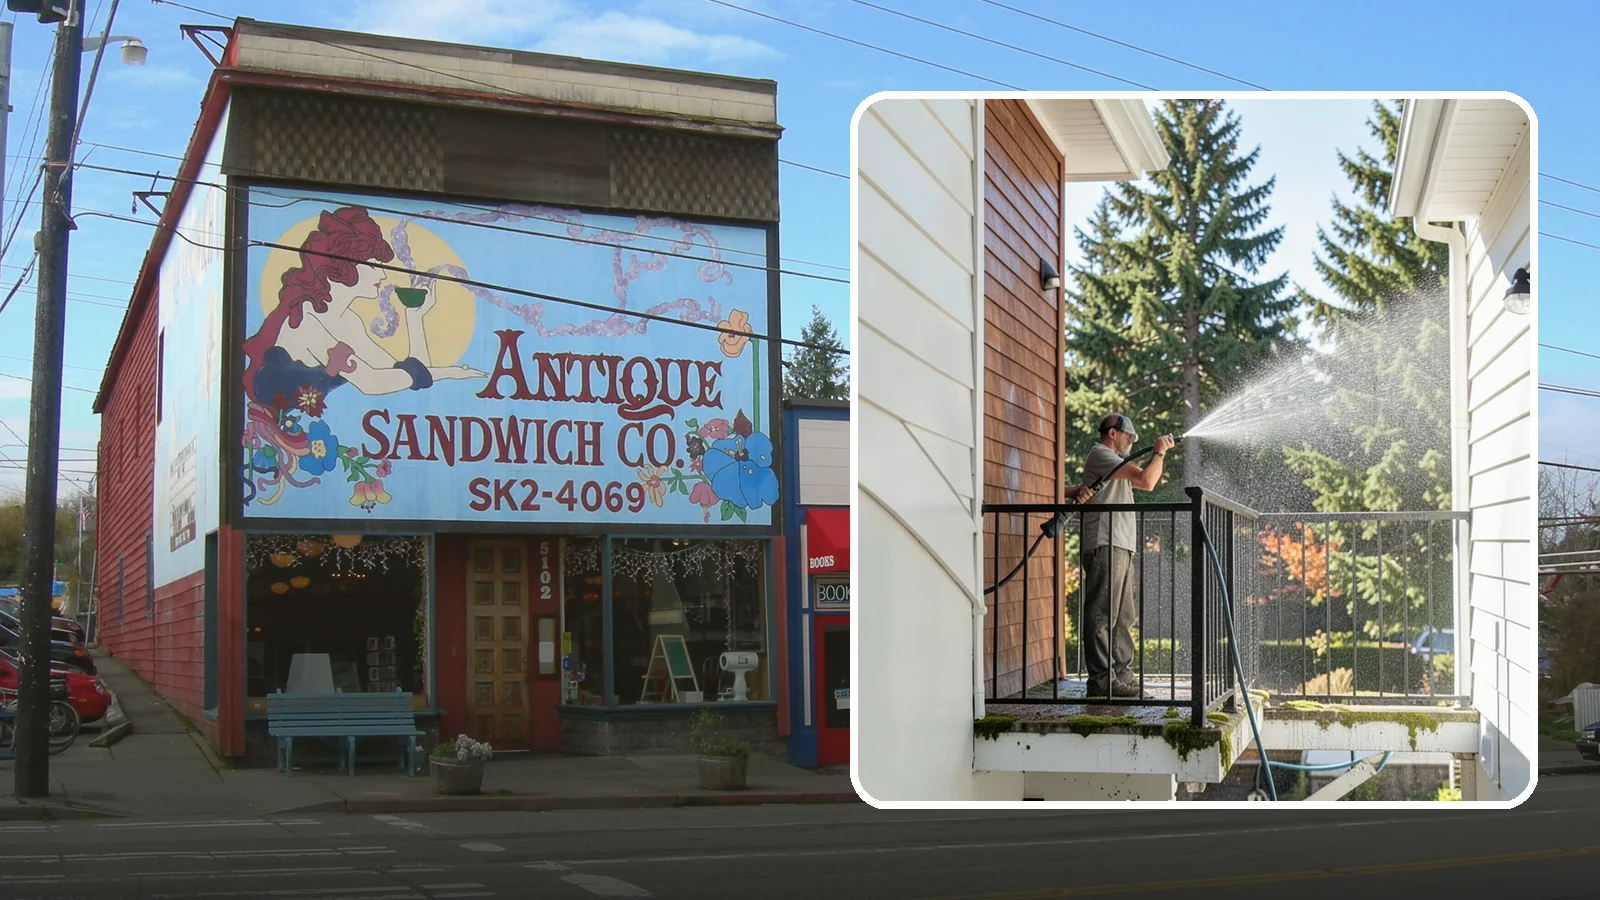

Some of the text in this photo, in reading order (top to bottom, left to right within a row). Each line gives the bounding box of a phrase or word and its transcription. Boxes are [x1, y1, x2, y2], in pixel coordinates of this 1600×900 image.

[476, 329, 723, 420] ANTIQUE
[361, 409, 685, 469] SANDWICH CO.
[468, 477, 645, 513] SK2-4069
[540, 541, 551, 600] 5102
[809, 555, 835, 568] BOOKS
